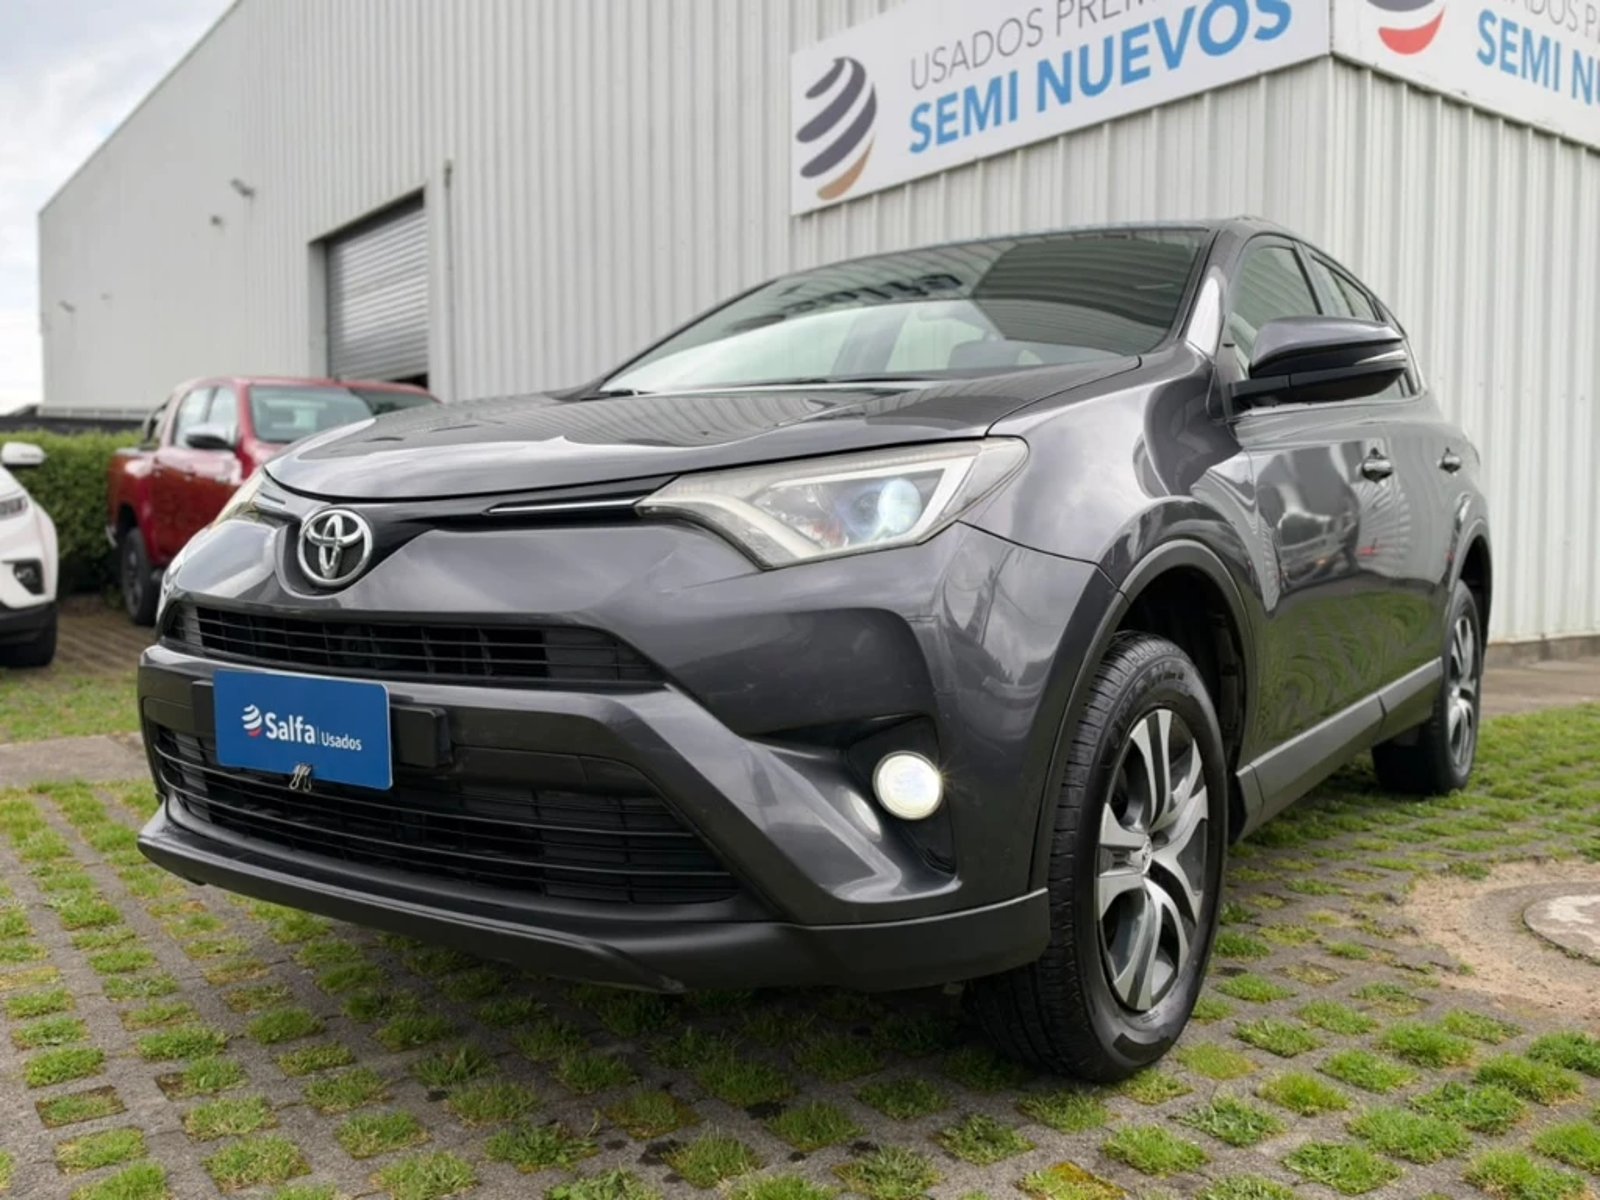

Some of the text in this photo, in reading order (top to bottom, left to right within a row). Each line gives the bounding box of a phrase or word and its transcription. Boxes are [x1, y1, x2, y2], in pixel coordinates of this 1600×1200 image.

[909, 0, 1293, 154] SEMI NUEVOS
[910, 7, 1044, 91] USADOS
[1477, 9, 1600, 105] SEMI N
[265, 712, 362, 751] Salfa Usados
